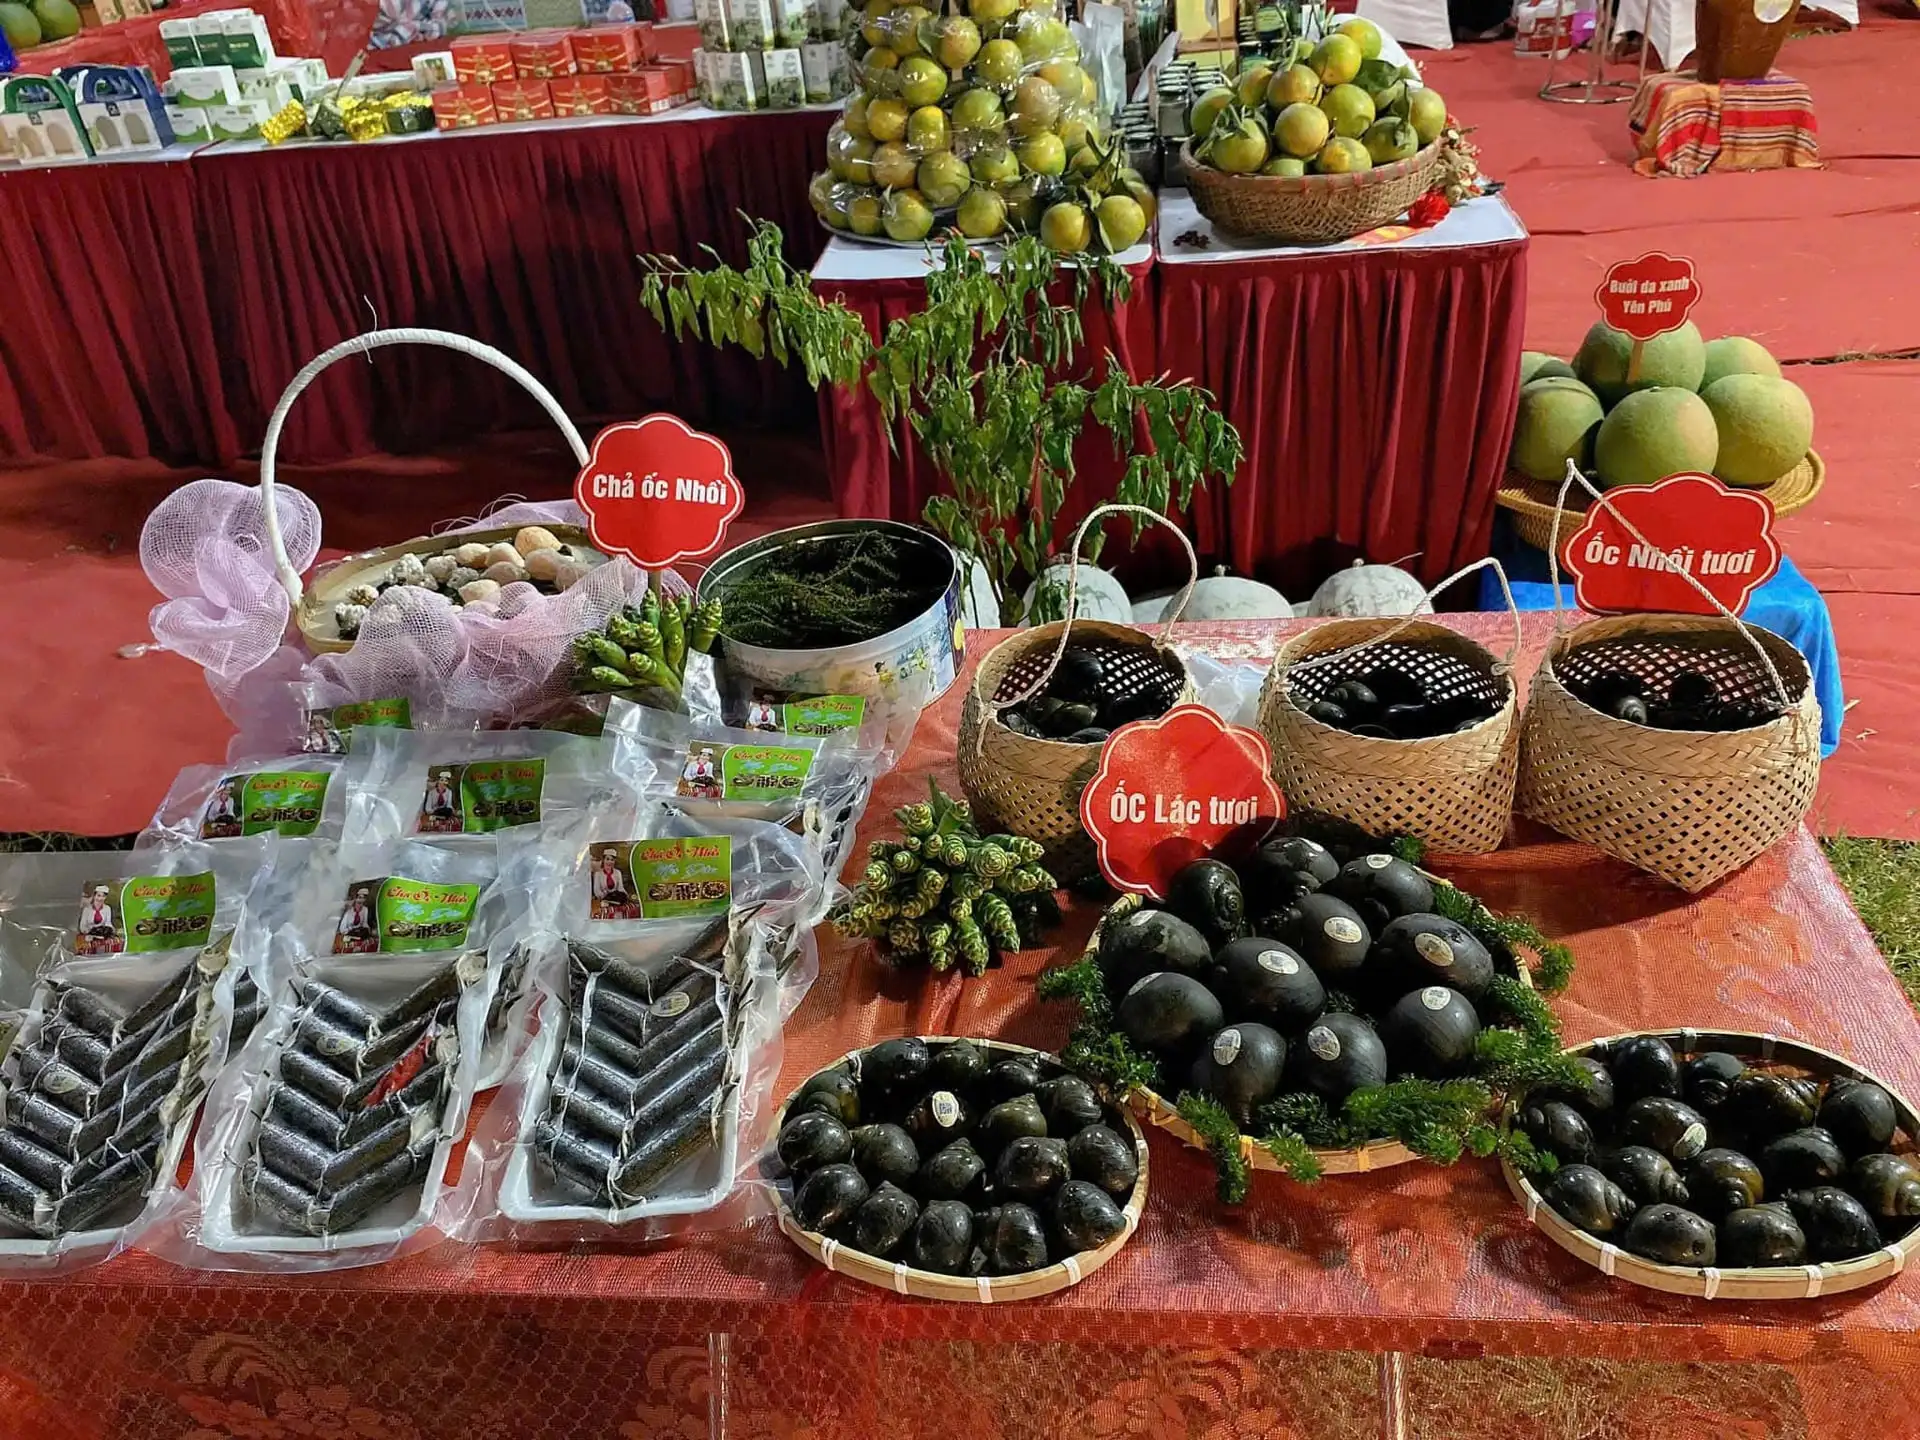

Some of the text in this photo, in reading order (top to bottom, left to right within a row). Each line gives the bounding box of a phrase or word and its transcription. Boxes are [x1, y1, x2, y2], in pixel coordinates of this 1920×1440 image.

[1659, 276, 1690, 292] xanh
[1622, 299, 1646, 314] Yên
[592, 471, 727, 505] Chả ốc Nhồi
[1584, 531, 1757, 576] Ốc Nhồi tươi
[1154, 793, 1201, 825] Lác
[1208, 795, 1259, 825] tươi
